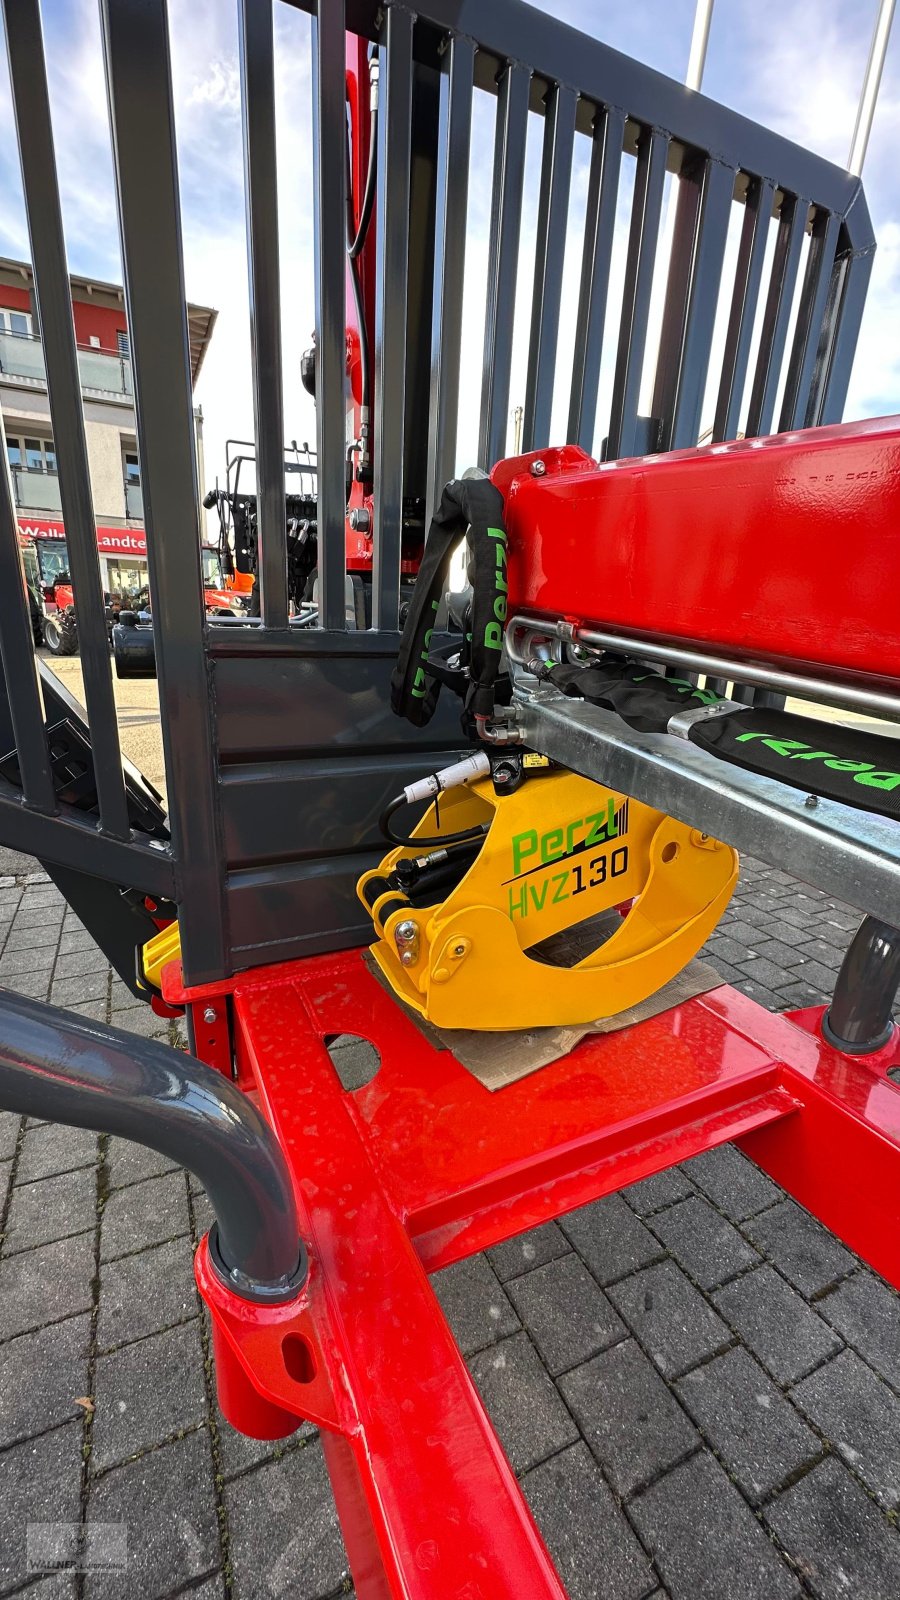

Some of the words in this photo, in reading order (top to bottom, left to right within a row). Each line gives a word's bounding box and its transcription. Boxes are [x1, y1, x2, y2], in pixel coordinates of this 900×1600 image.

[98, 535, 147, 549] andte
[512, 797, 618, 876] Perzl
[509, 846, 628, 921] HVZ130
